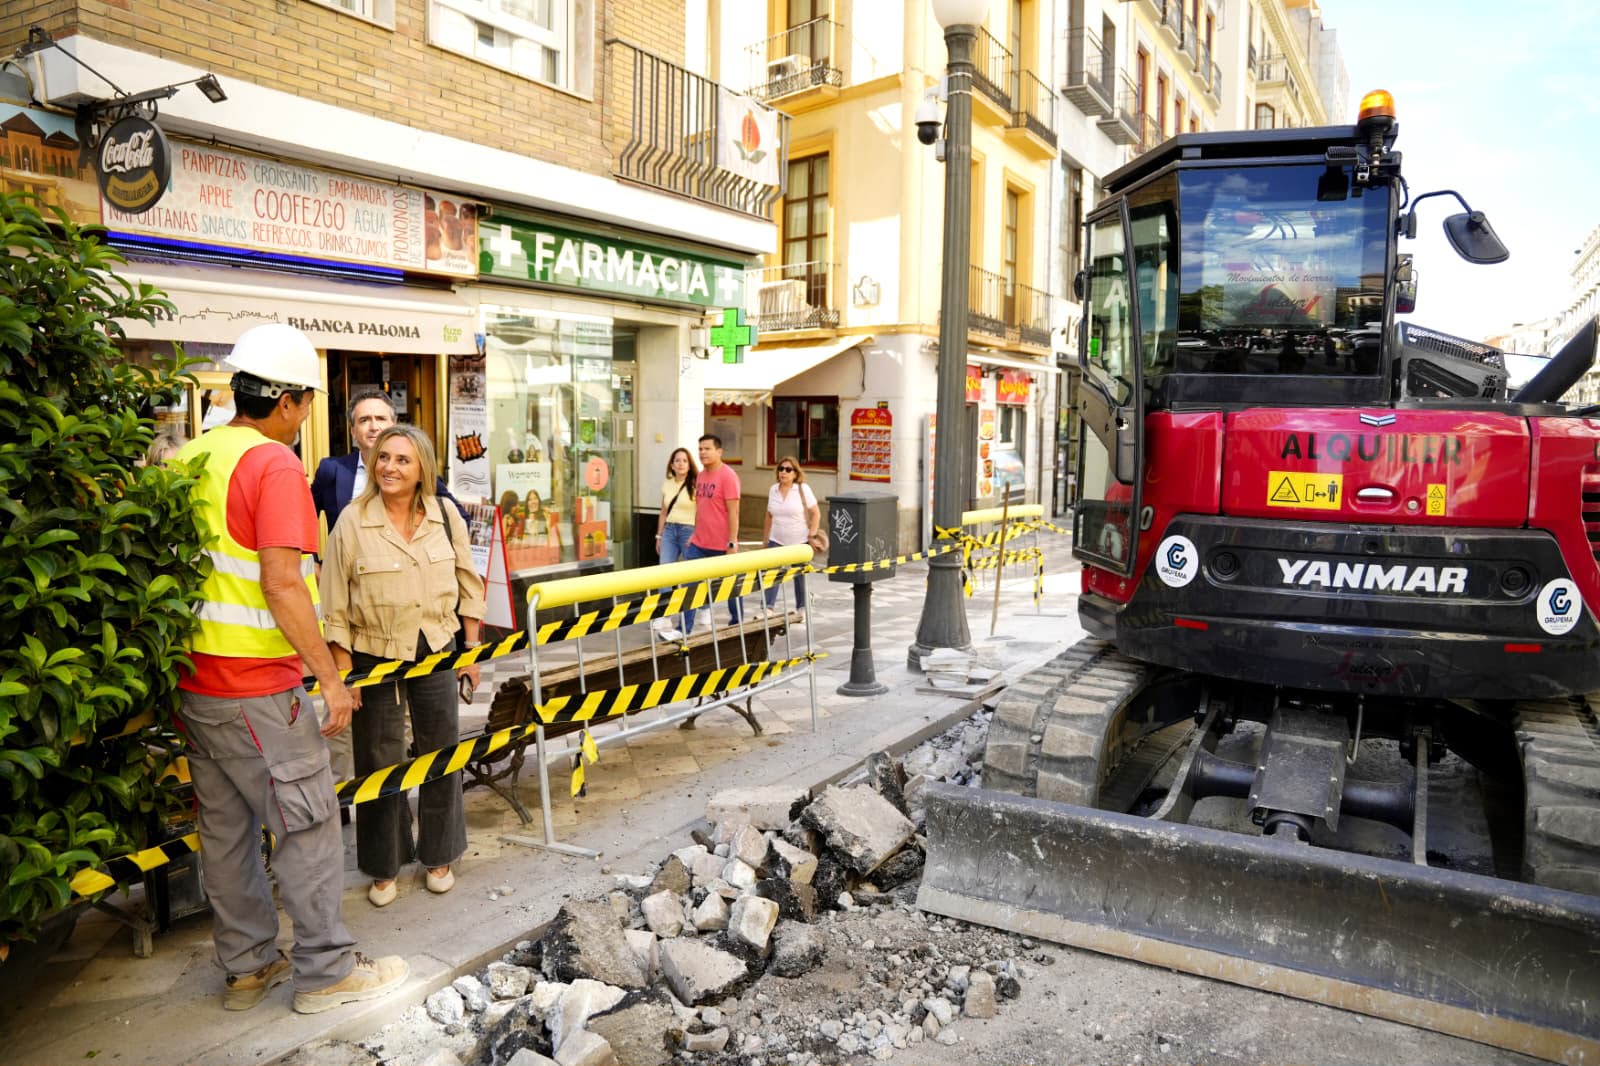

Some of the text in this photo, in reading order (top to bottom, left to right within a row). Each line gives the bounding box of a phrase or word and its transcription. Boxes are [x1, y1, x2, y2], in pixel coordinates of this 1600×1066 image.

[182, 148, 247, 181] PANPIZZAS
[254, 164, 318, 193] CROISSANTS
[199, 183, 233, 208] APPLE
[328, 179, 388, 207] EMPANADAS
[254, 188, 345, 231] COOFE2GO
[354, 207, 388, 236] AGUA
[202, 214, 247, 239] SNACKS
[252, 221, 313, 249] REFRESCOS
[393, 191, 409, 262] PIONONOS
[319, 231, 388, 259] DRINKS ZUMOS
[535, 232, 709, 297] FARMACIA
[287, 316, 421, 339] BLANCA PALOMA
[1281, 433, 1462, 465] ALQUILER
[1278, 558, 1469, 594] YANMAR
